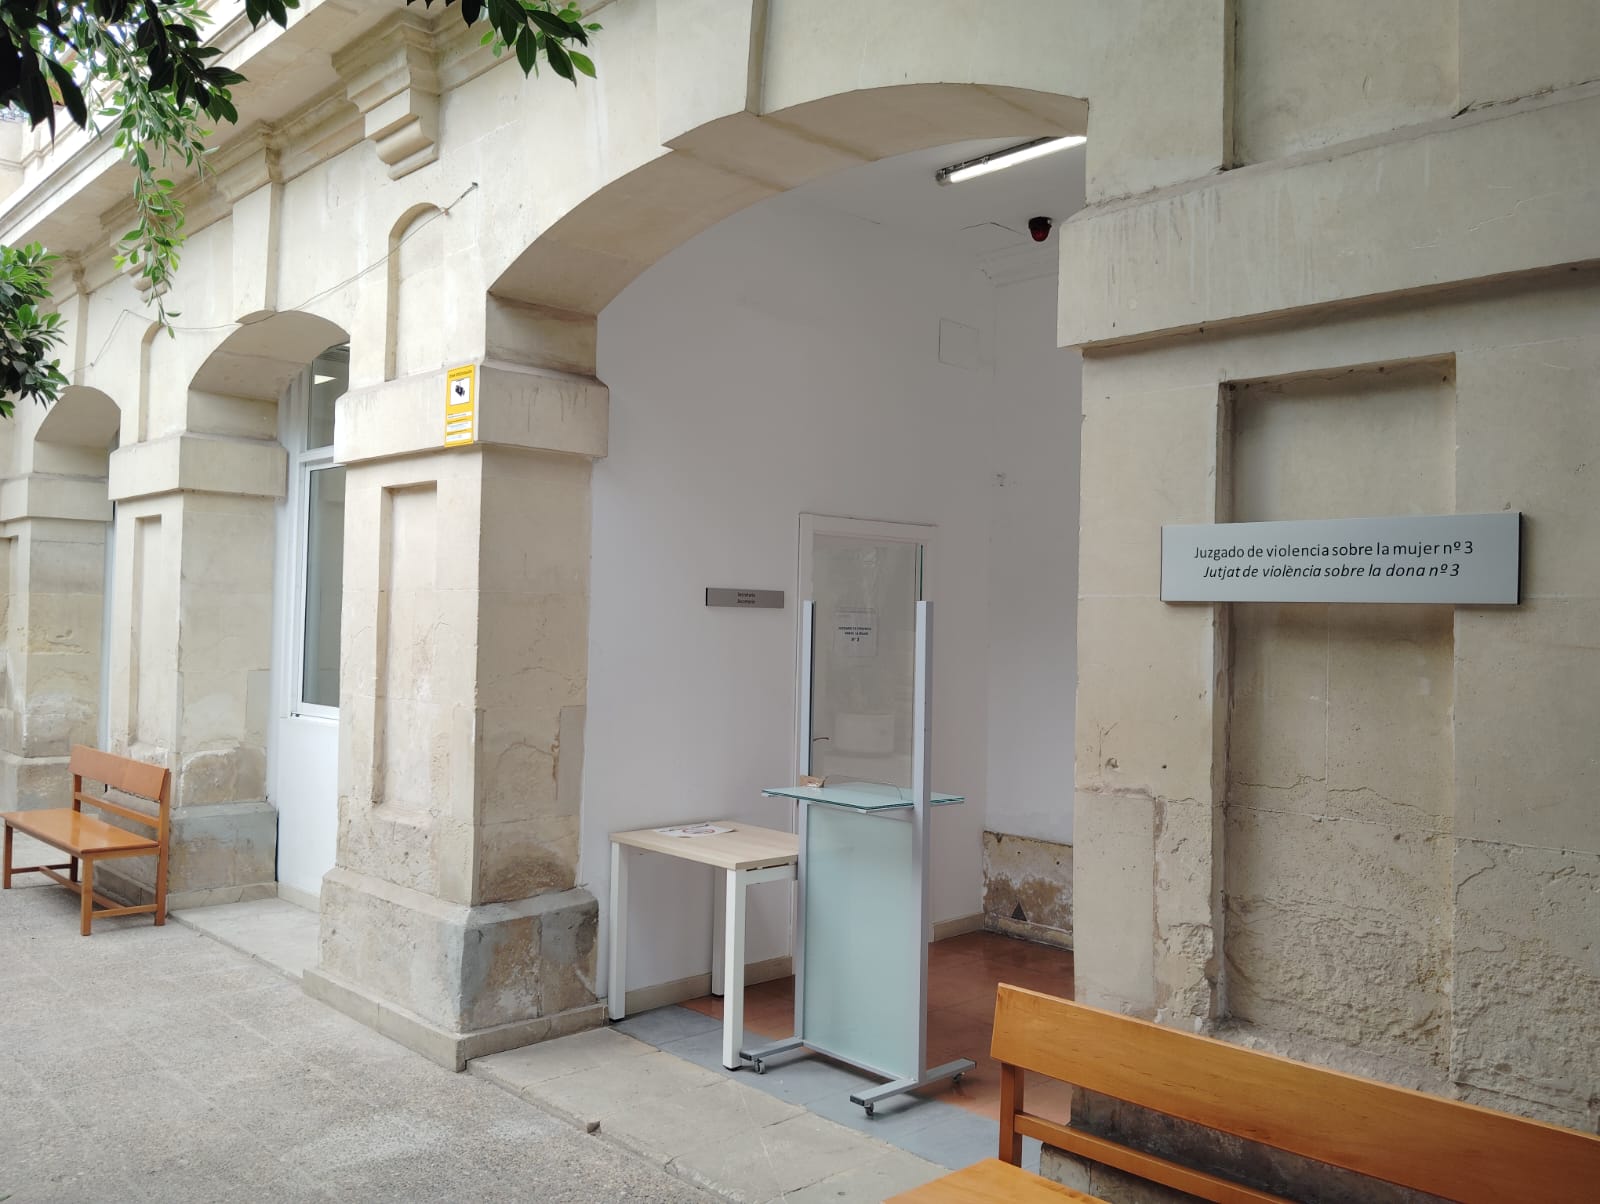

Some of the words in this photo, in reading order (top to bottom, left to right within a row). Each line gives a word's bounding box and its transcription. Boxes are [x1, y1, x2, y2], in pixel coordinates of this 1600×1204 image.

[1194, 545, 1245, 561] Juzgado
[1247, 545, 1264, 558] de
[1266, 544, 1329, 558] violencia
[1331, 542, 1373, 556] sobre
[1376, 542, 1389, 556] la
[1393, 541, 1440, 558] mujer
[1203, 565, 1241, 580] Jutjat
[1242, 565, 1259, 578] de
[1262, 564, 1322, 578] violència
[1323, 563, 1365, 577] sobre
[1368, 563, 1382, 577] la
[1385, 563, 1426, 577] dona
